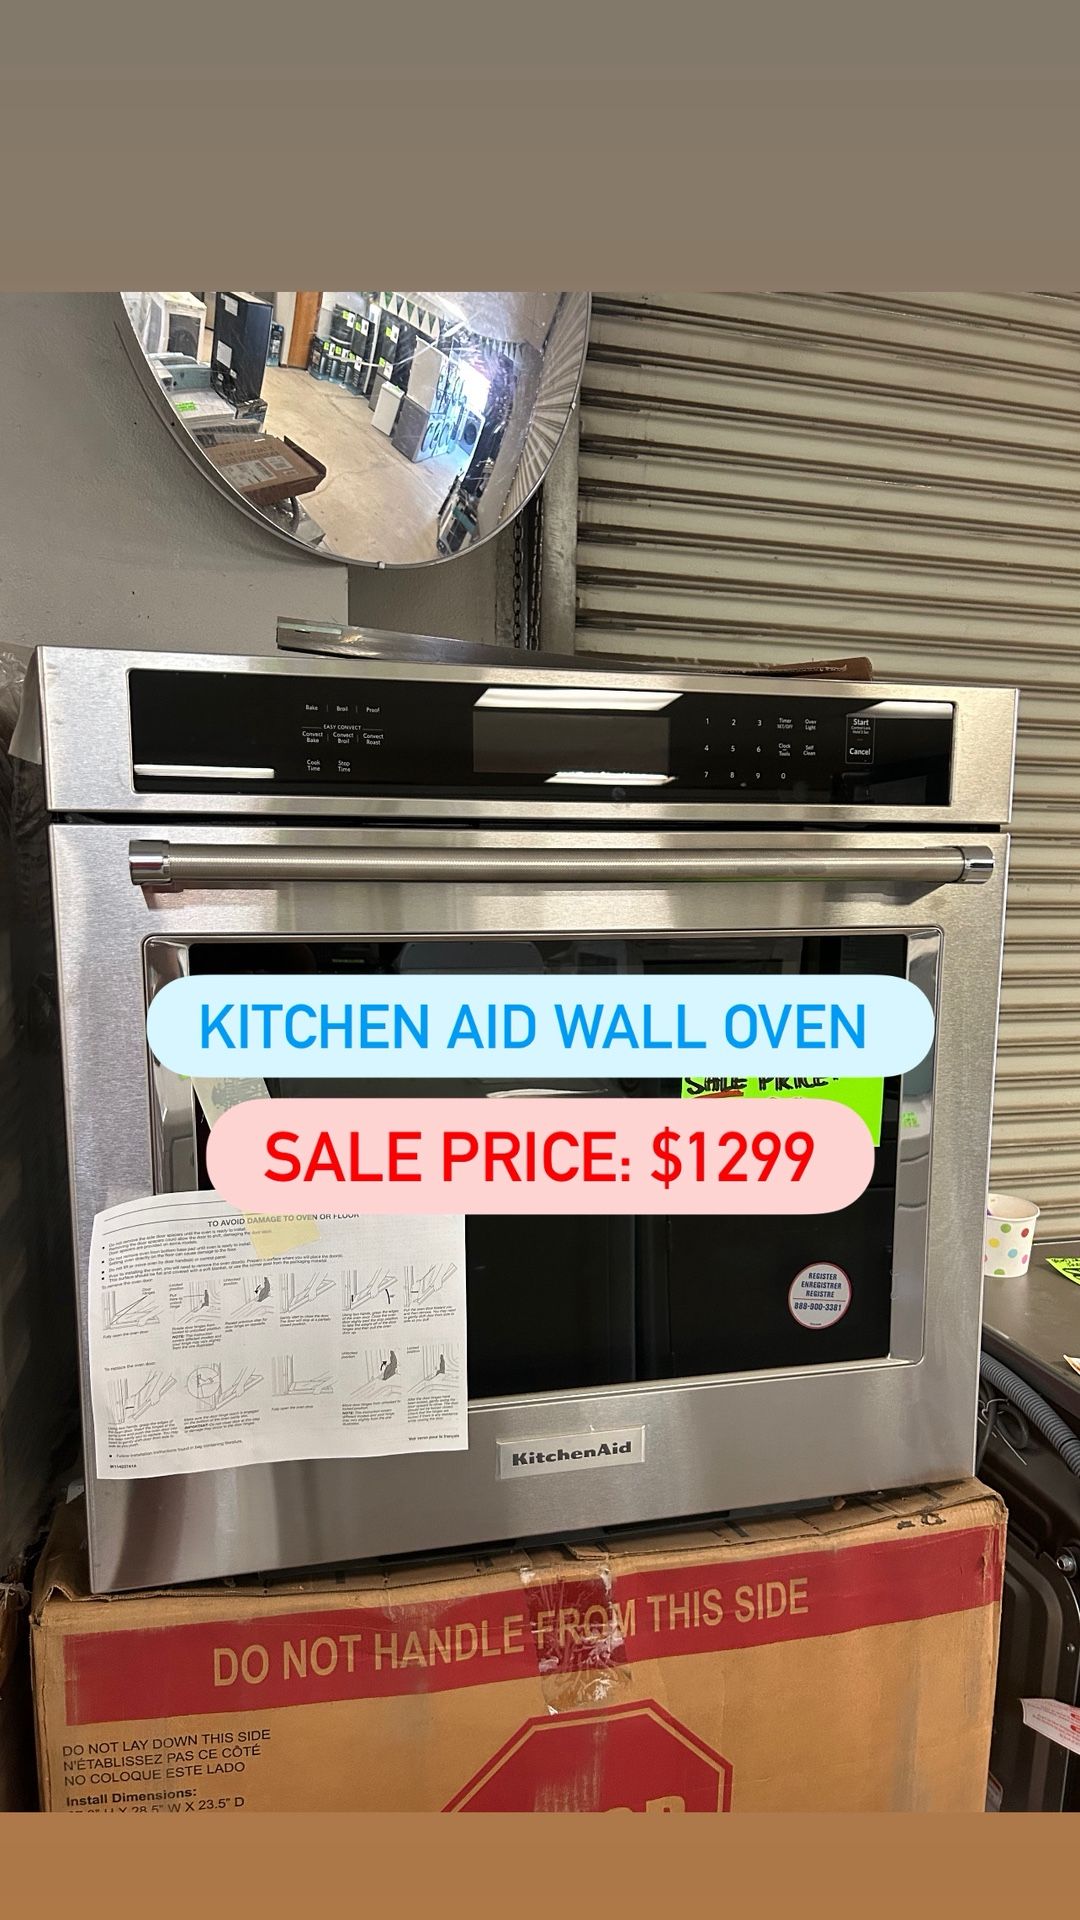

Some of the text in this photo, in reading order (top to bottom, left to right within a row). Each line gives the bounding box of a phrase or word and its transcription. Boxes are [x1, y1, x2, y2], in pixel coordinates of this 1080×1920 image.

[247, 1216, 282, 1224] DAMAGE
[801, 1281, 842, 1289] ENREGISTRER
[806, 1290, 835, 1298] REGISTRE
[794, 1302, 841, 1311] 888-900-3381
[512, 1441, 632, 1467] KitchenAid
[213, 1577, 809, 1687] DO NOT HANDLE FROM THIS SIDE
[63, 1729, 271, 1756] DO NOT LAY DOWN THIS SIDE
[64, 1743, 261, 1771] N'ÉTABLISSEZ PAS CE CÔTÉ
[65, 1762, 245, 1786] NO COLOQUE ESTE LADO
[67, 1789, 197, 1806] Install Dimensions:
[168, 1803, 181, 1812] W
[185, 1802, 195, 1812] X
[235, 1797, 244, 1807] D
